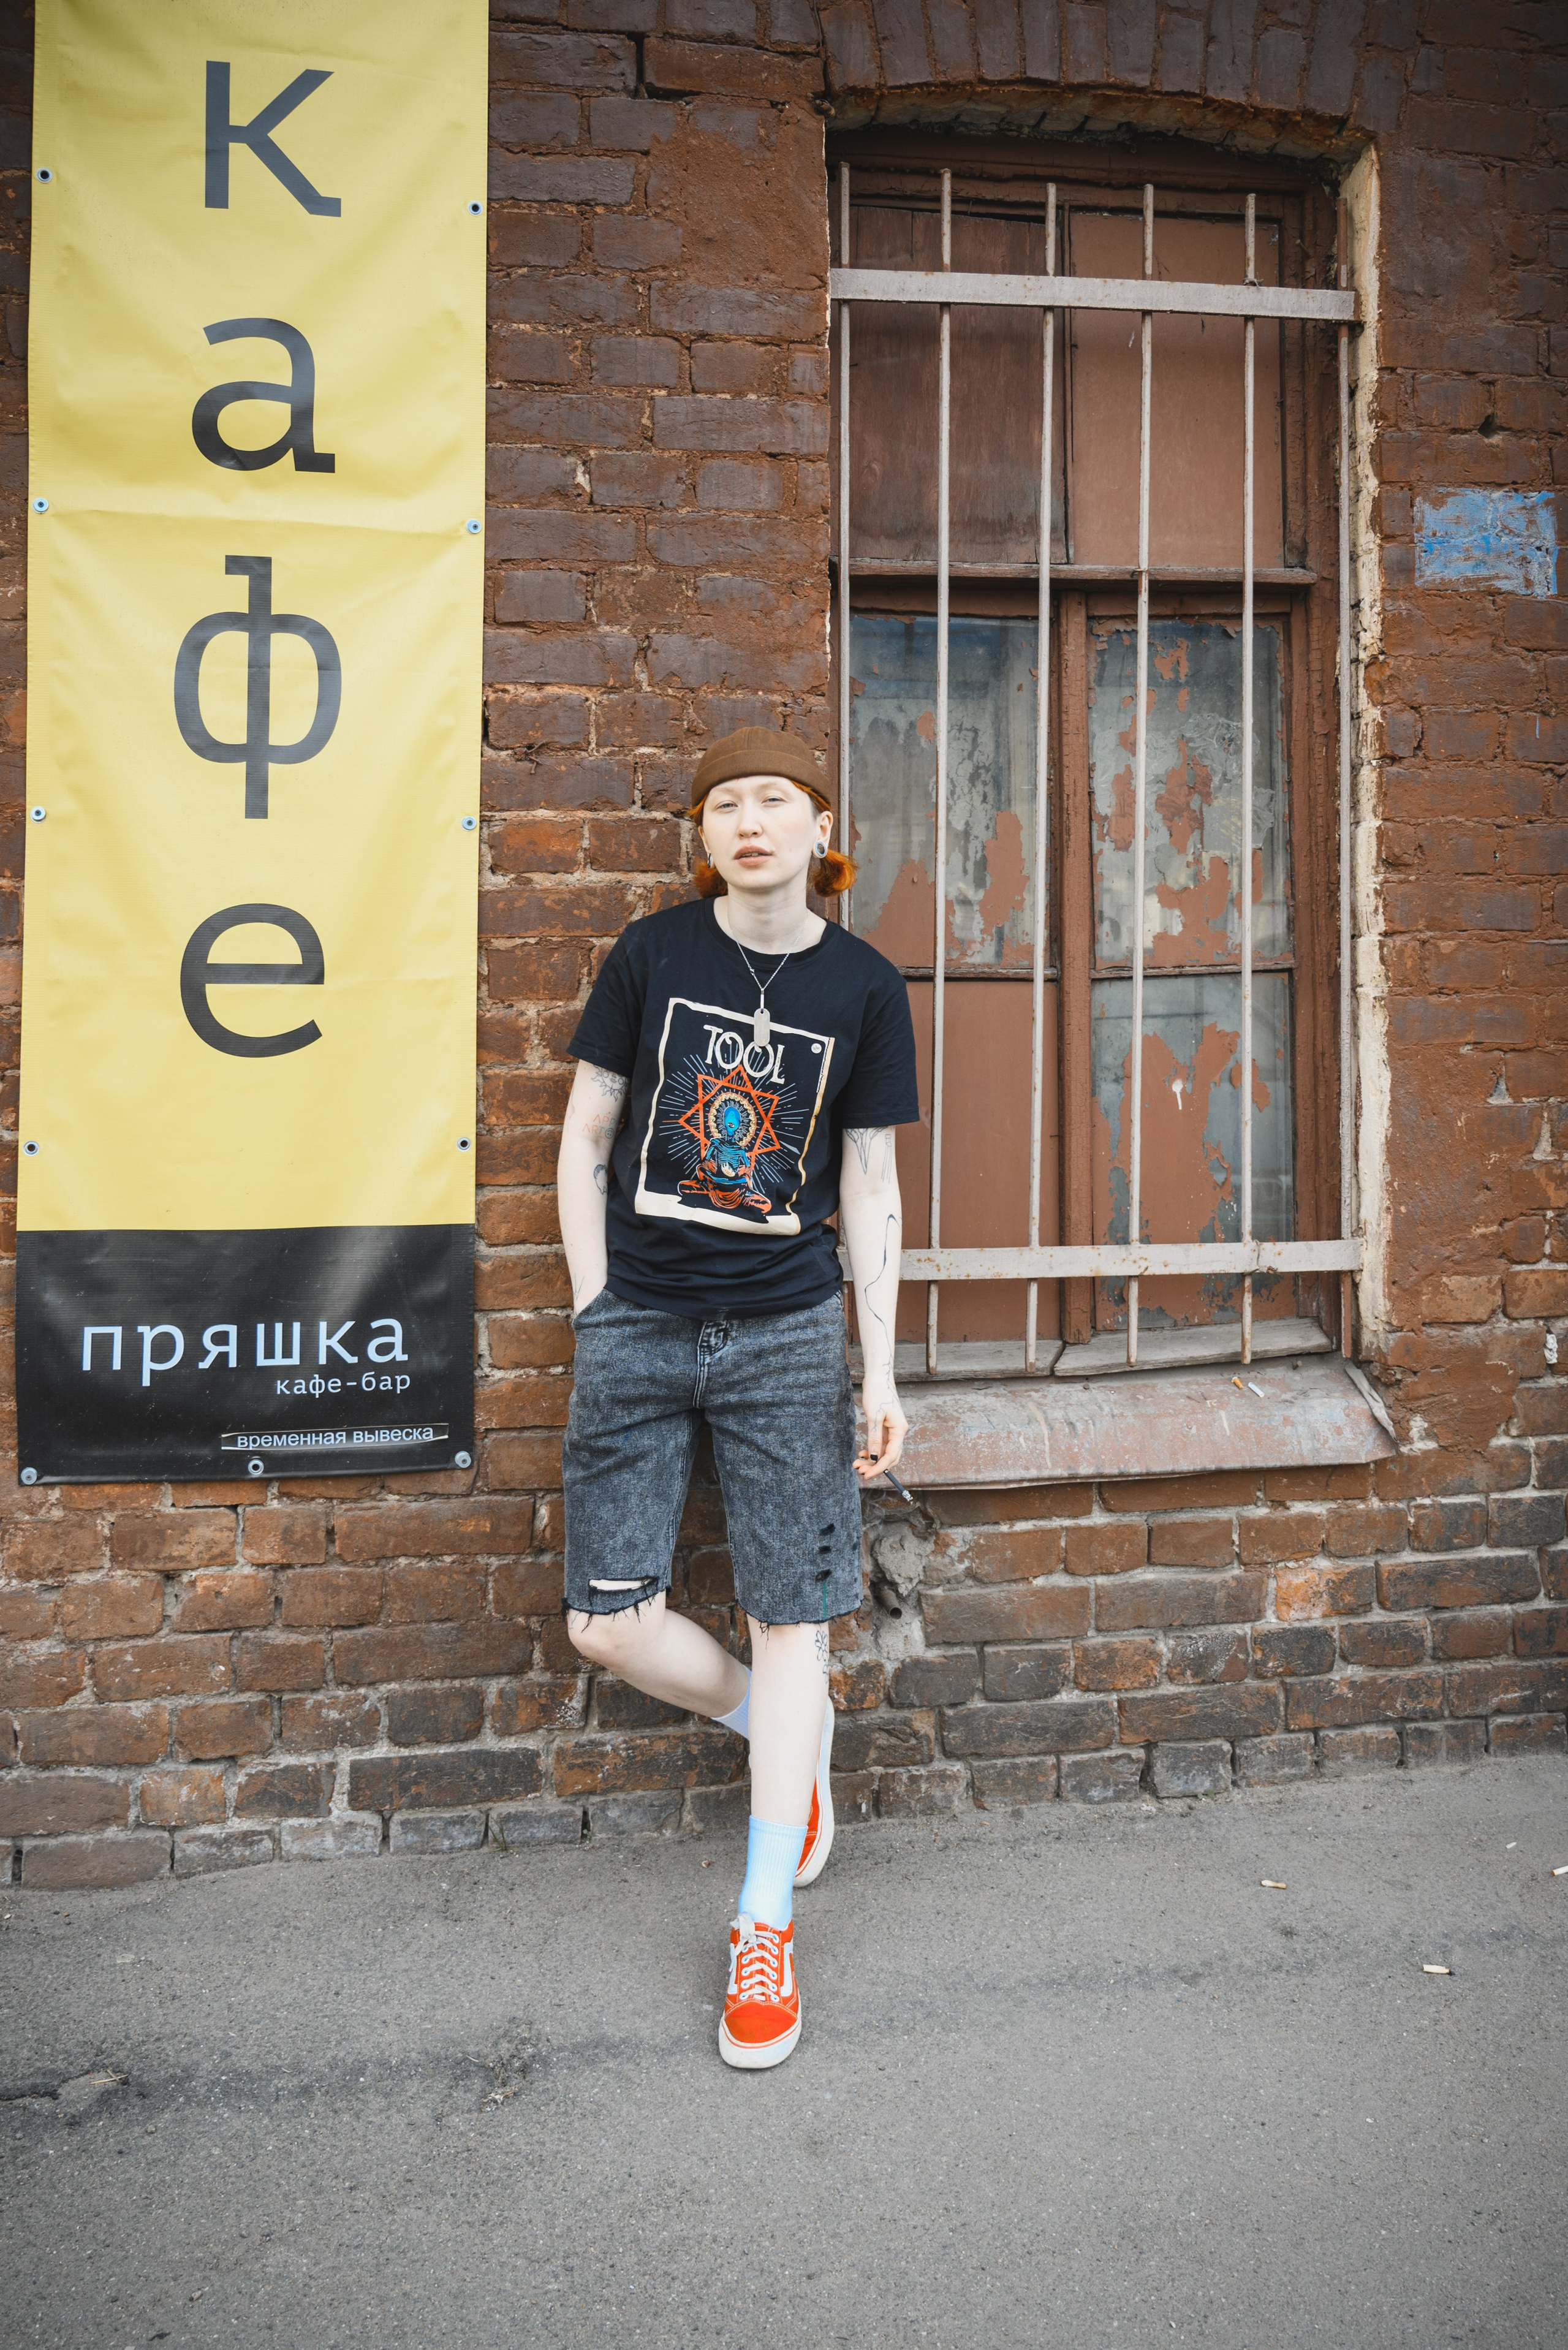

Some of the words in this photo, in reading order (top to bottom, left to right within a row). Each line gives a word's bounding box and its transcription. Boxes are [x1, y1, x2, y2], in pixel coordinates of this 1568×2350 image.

[174, 60, 342, 1058] кафе
[703, 1025, 785, 1084] TOOL
[82, 1317, 409, 1387] пряшка
[276, 1371, 411, 1398] кафе-бар
[237, 1431, 347, 1450] временная
[352, 1423, 434, 1442] вывеска
